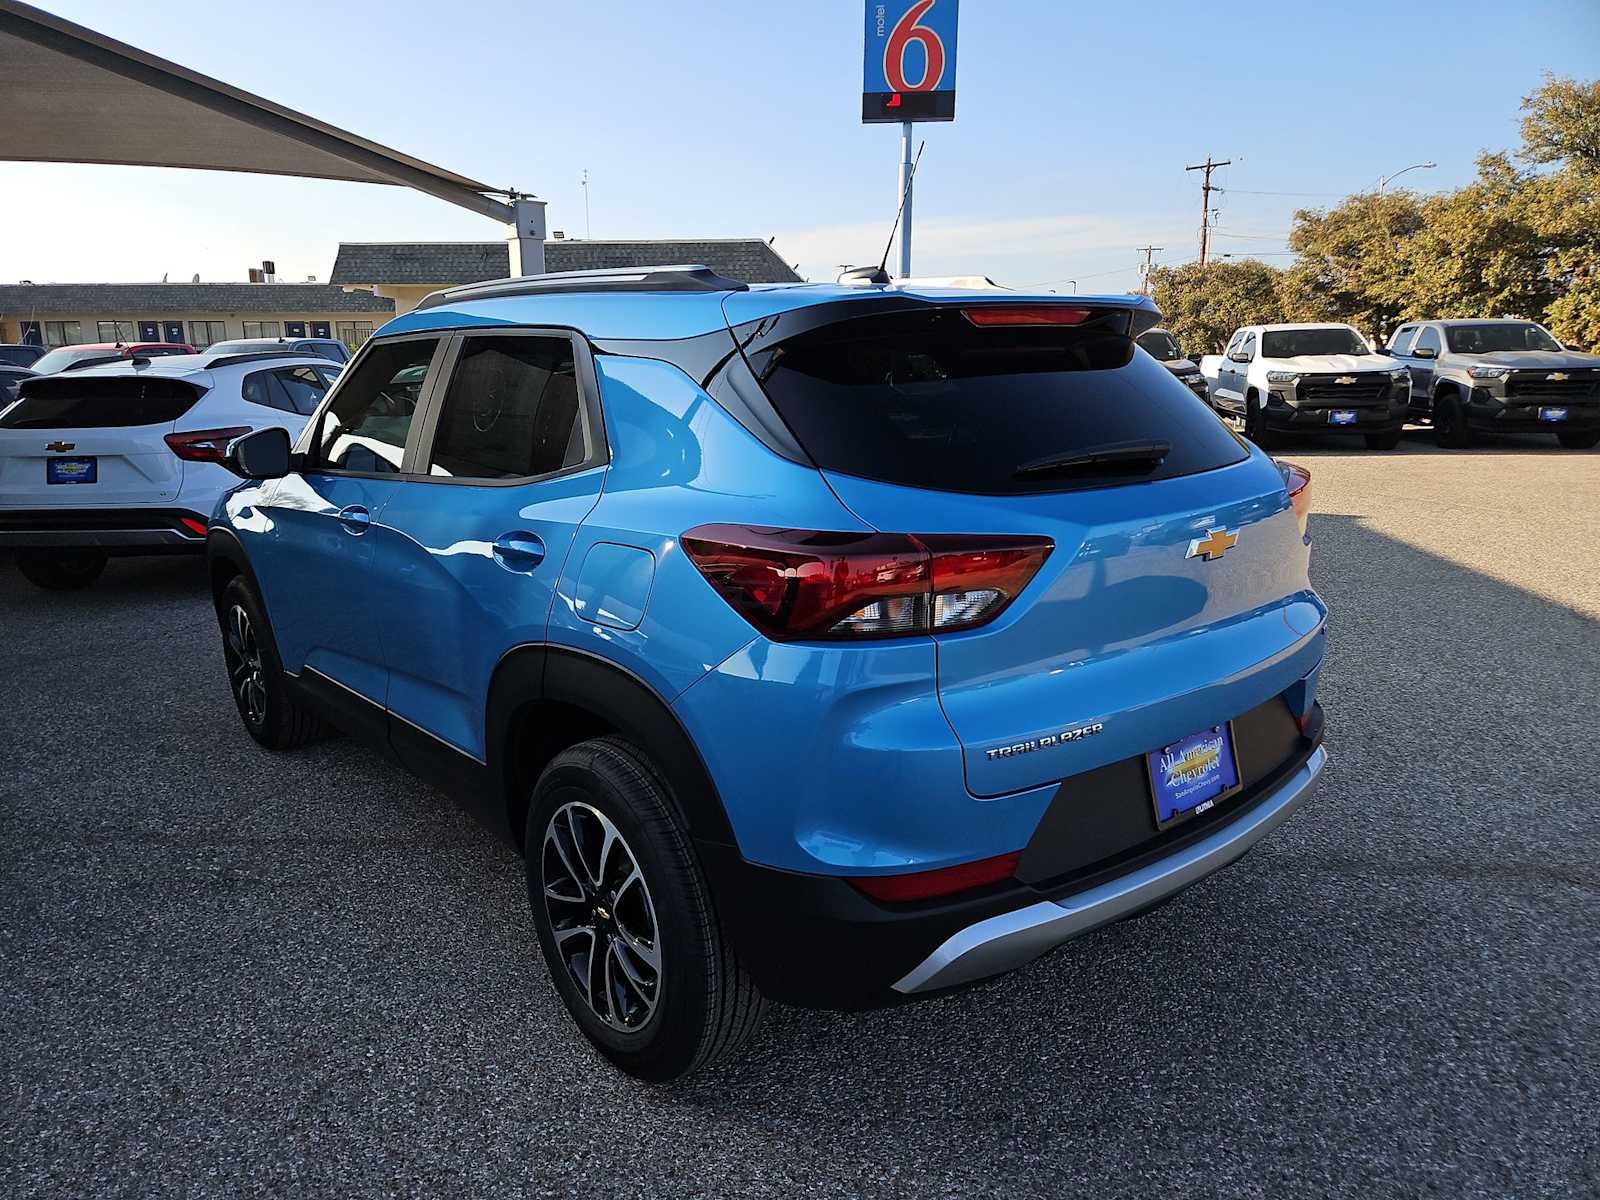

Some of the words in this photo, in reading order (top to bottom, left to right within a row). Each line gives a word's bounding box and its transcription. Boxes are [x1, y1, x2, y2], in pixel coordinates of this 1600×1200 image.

[876, 4, 885, 37] motel
[883, 0, 945, 92] 6
[985, 721, 1105, 761] TRAILBLAZER
[1160, 752, 1175, 773] All
[1175, 736, 1224, 765] American
[1167, 756, 1220, 788] Chevrolet
